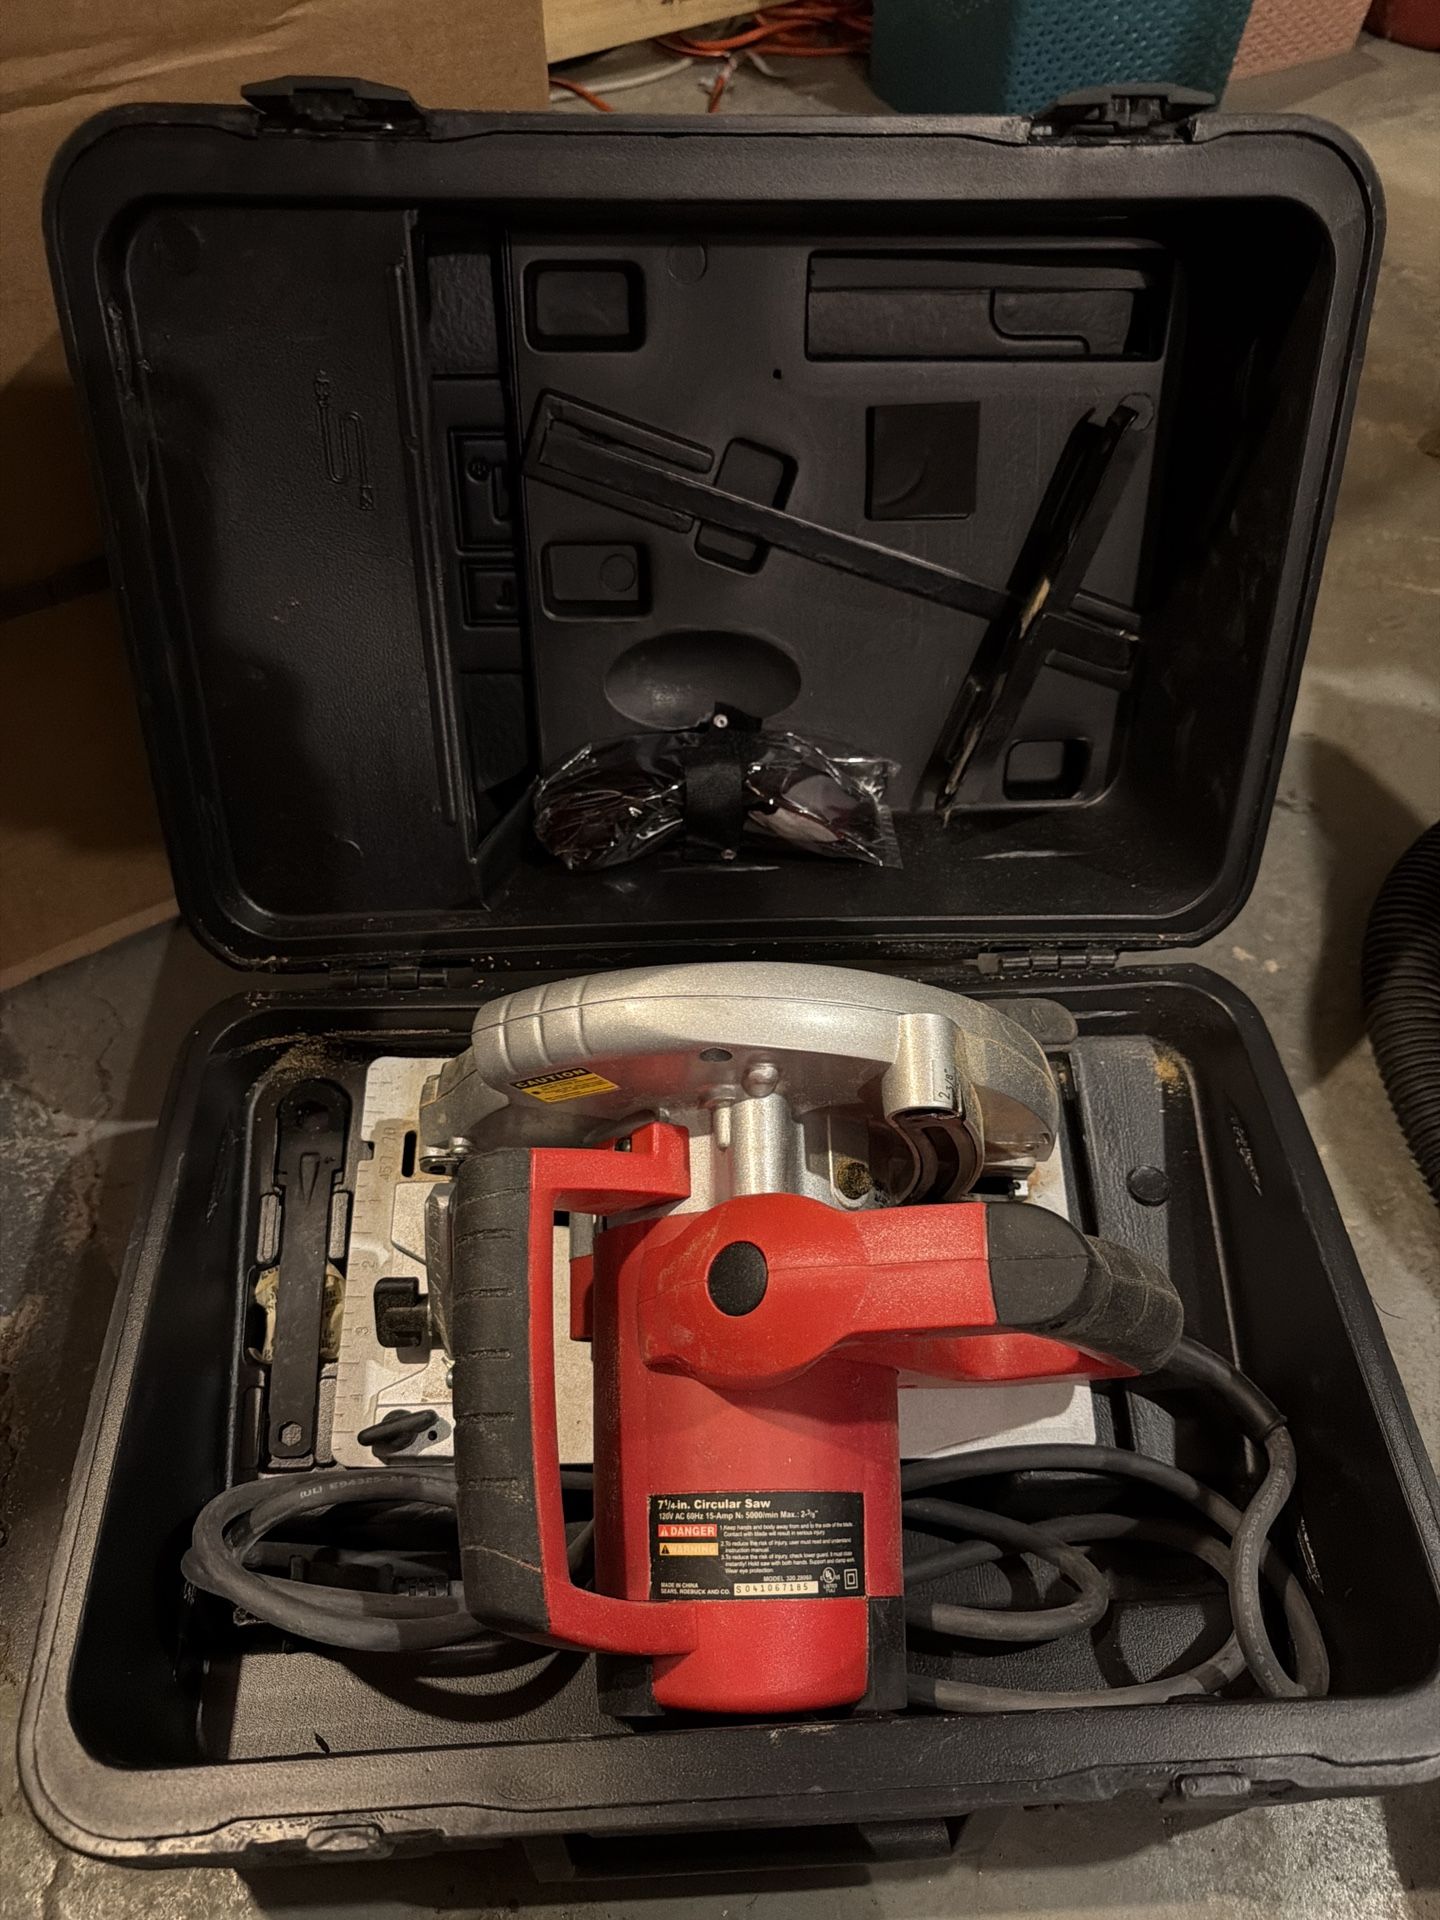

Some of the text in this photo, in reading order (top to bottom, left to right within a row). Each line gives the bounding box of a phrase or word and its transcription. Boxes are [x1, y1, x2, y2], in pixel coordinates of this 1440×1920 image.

[515, 1068, 587, 1089] CAUTION
[693, 1499, 742, 1510] Circular
[744, 1498, 772, 1509] Saw
[675, 1511, 685, 1520] AC
[686, 1511, 704, 1520] 60Hz
[705, 1511, 734, 1521] 15-Amp
[745, 1510, 779, 1520] 5000/min
[670, 1525, 715, 1536] DANGER
